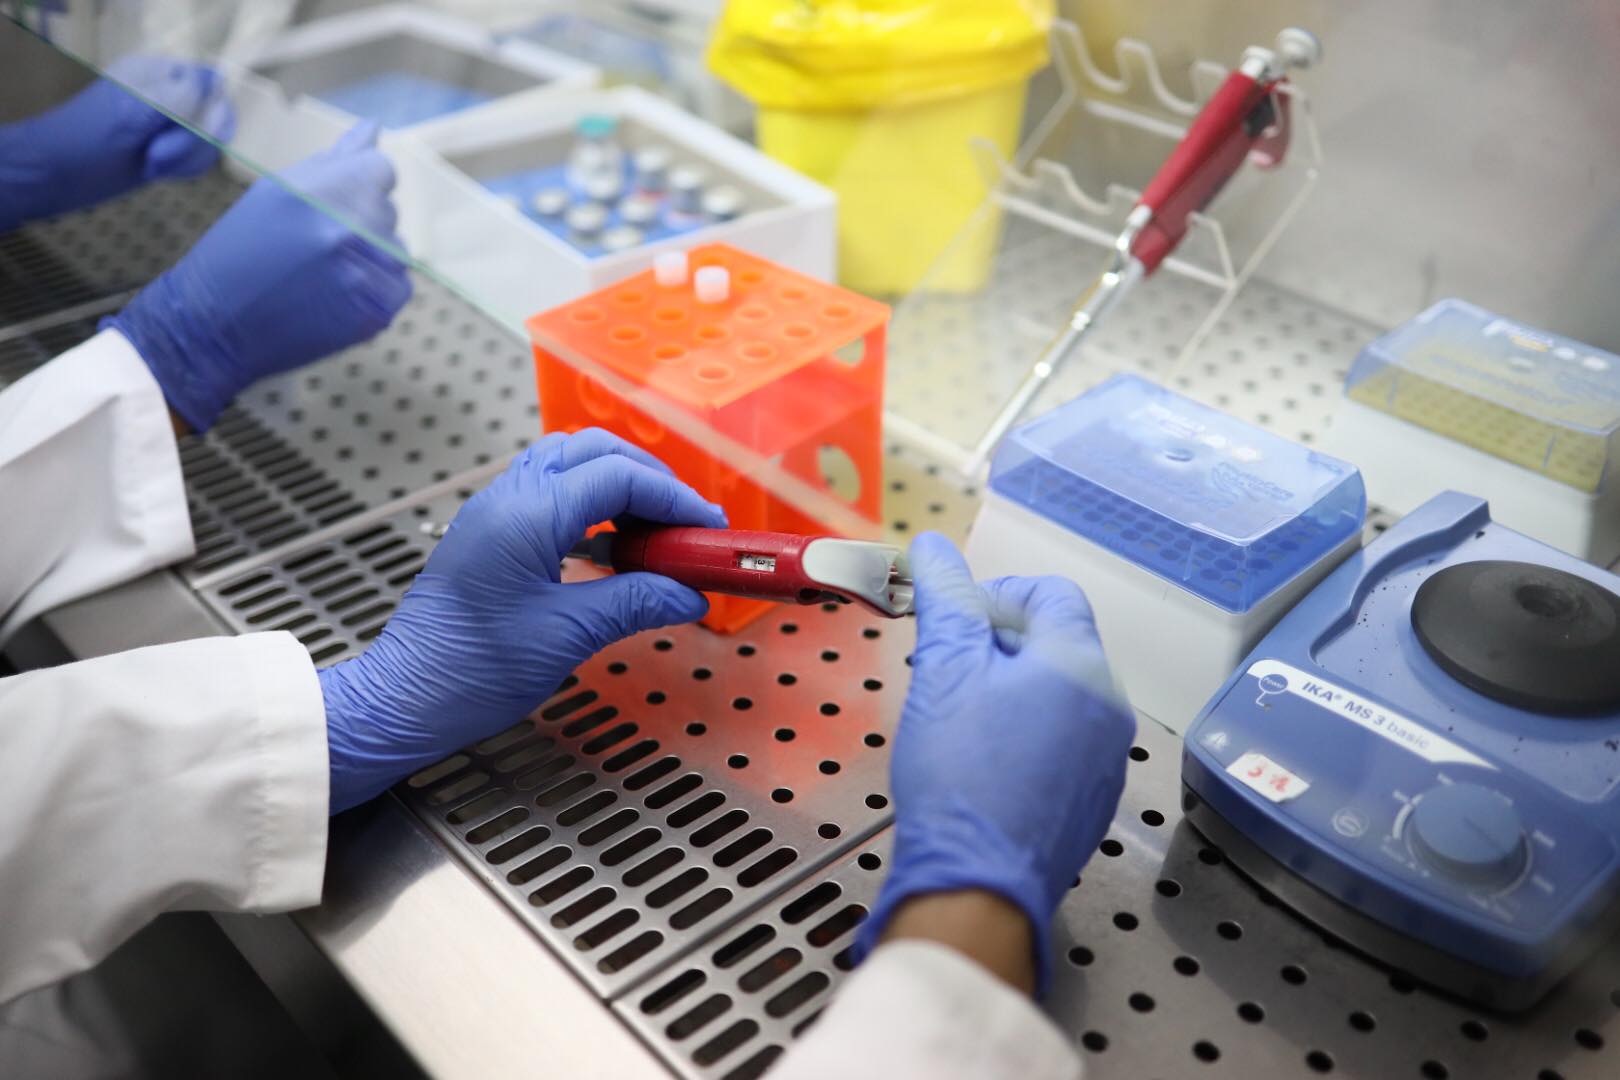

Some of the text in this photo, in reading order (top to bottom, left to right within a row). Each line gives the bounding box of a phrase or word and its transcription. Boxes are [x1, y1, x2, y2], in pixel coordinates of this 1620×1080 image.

[1344, 700, 1374, 719] MS
[1373, 714, 1387, 726] 3
[1387, 721, 1431, 749] basic
